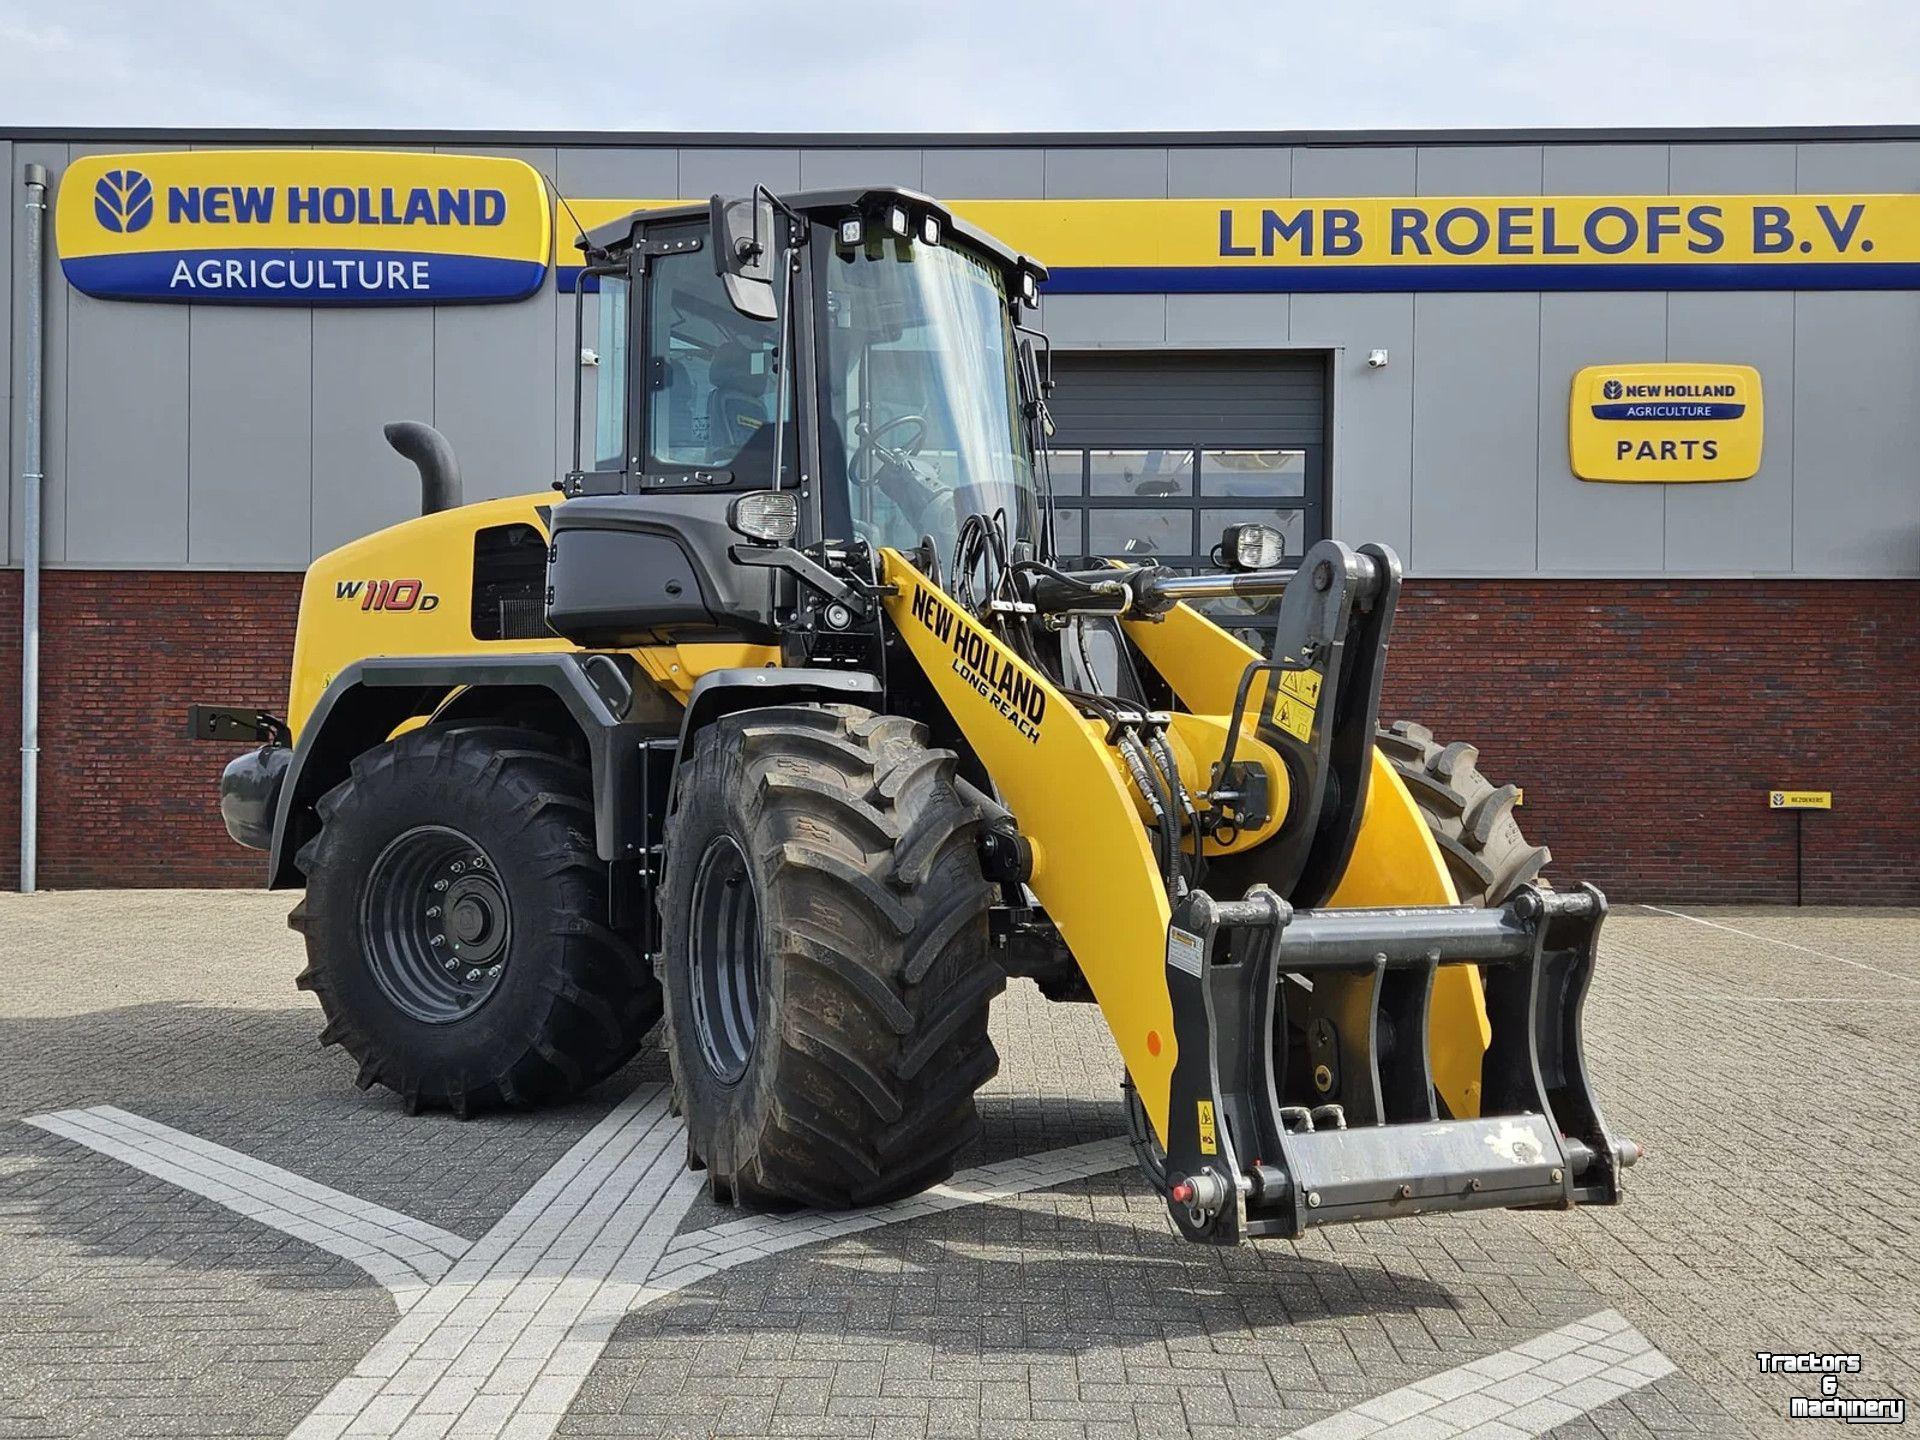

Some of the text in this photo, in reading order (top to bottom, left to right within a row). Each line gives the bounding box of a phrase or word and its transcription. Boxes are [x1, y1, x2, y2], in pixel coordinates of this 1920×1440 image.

[168, 186, 507, 226] NEW HOLLAND
[1219, 203, 1874, 257] LMB ROELOFS B.V.
[169, 258, 431, 290] AGRICULTURE
[1626, 385, 1736, 398] NEW HOLLAND
[1626, 405, 1712, 417] AGRICULTURE
[1616, 440, 1719, 461] PARTS
[911, 583, 1047, 726] NEW HOLLAND
[951, 657, 1041, 744] LONG REACH
